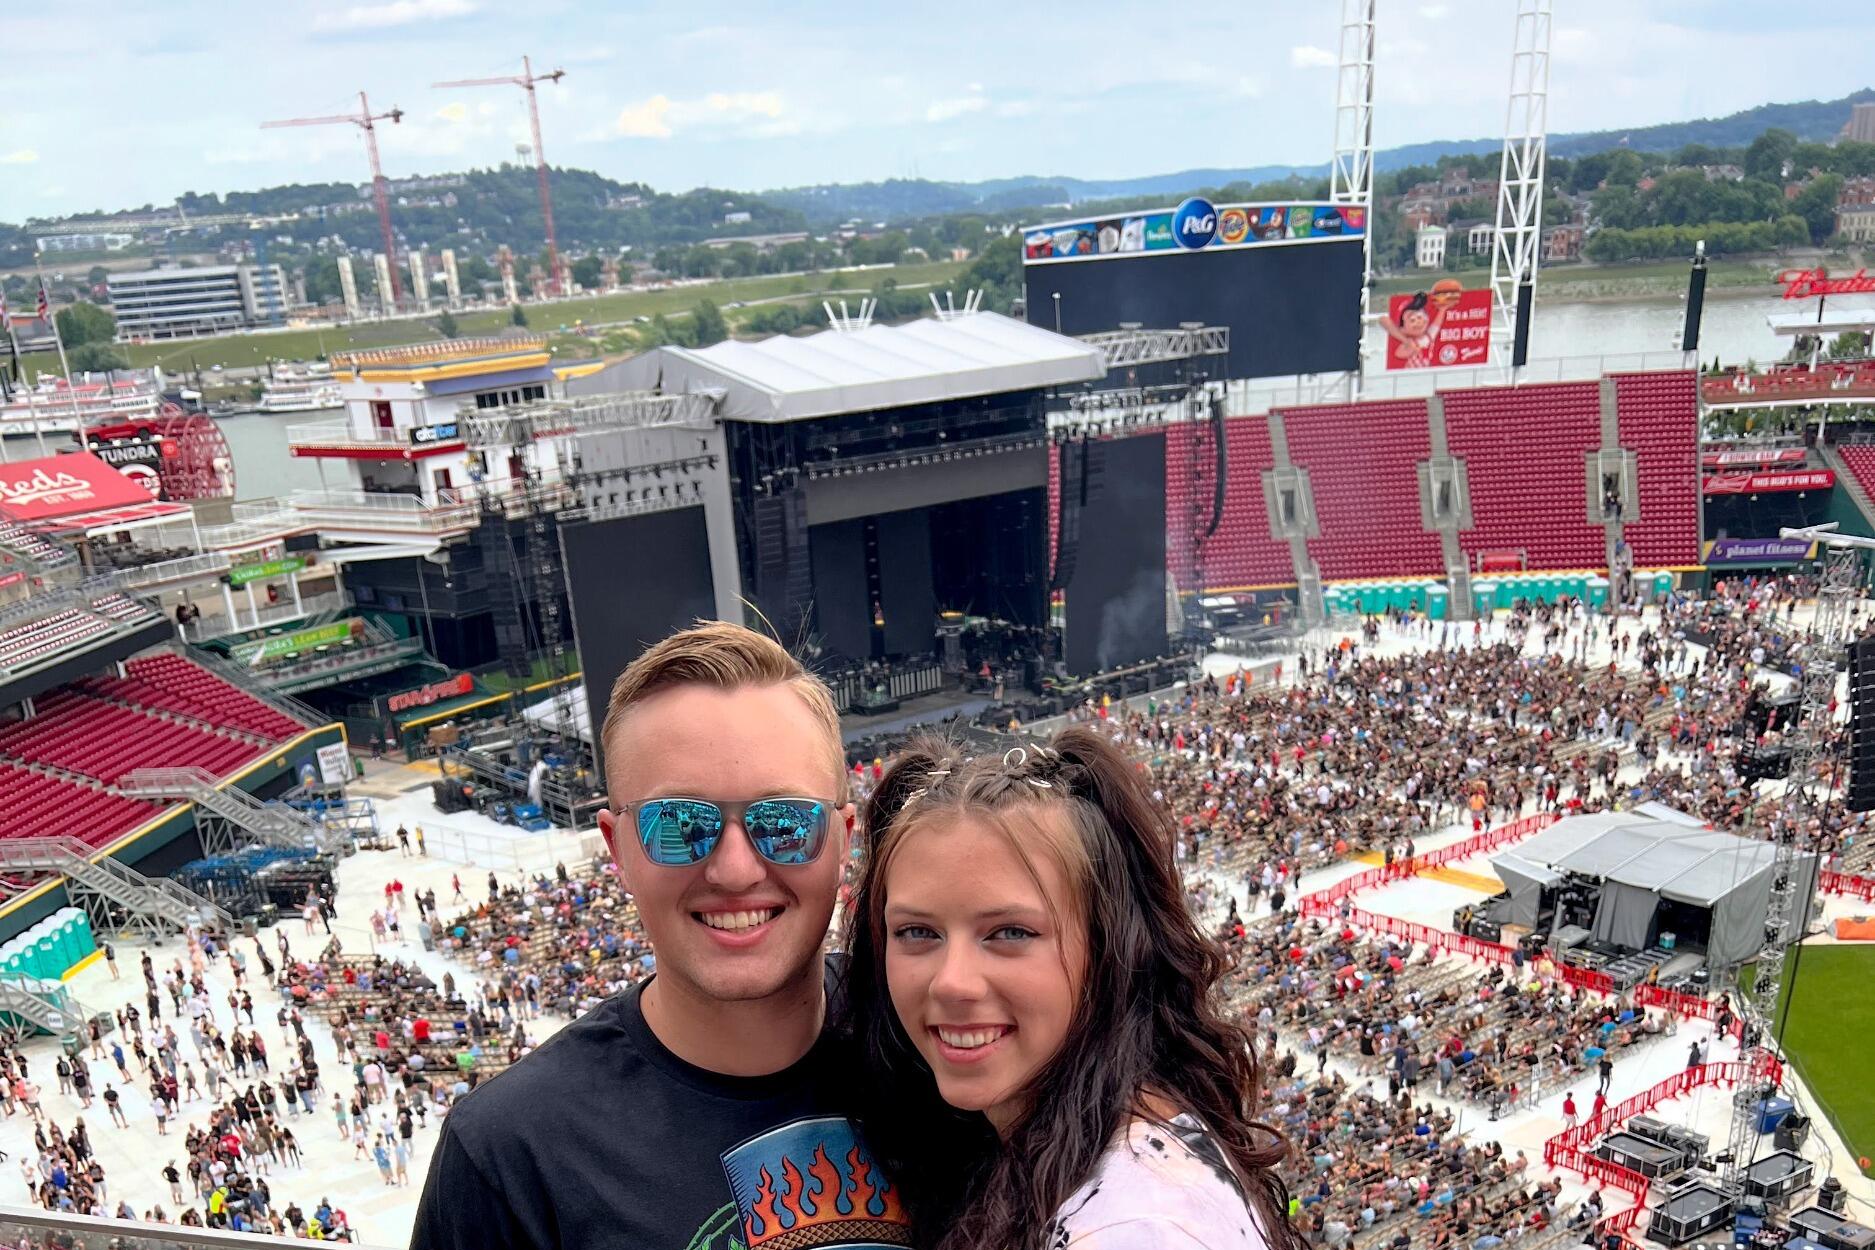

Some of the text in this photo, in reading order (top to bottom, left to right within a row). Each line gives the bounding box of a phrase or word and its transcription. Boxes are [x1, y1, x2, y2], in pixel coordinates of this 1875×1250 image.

[1183, 213, 1215, 235] P&G
[1440, 326, 1488, 341] BIG BOY
[98, 444, 159, 462] TUNDRA
[1725, 543, 1807, 560] planet fitness
